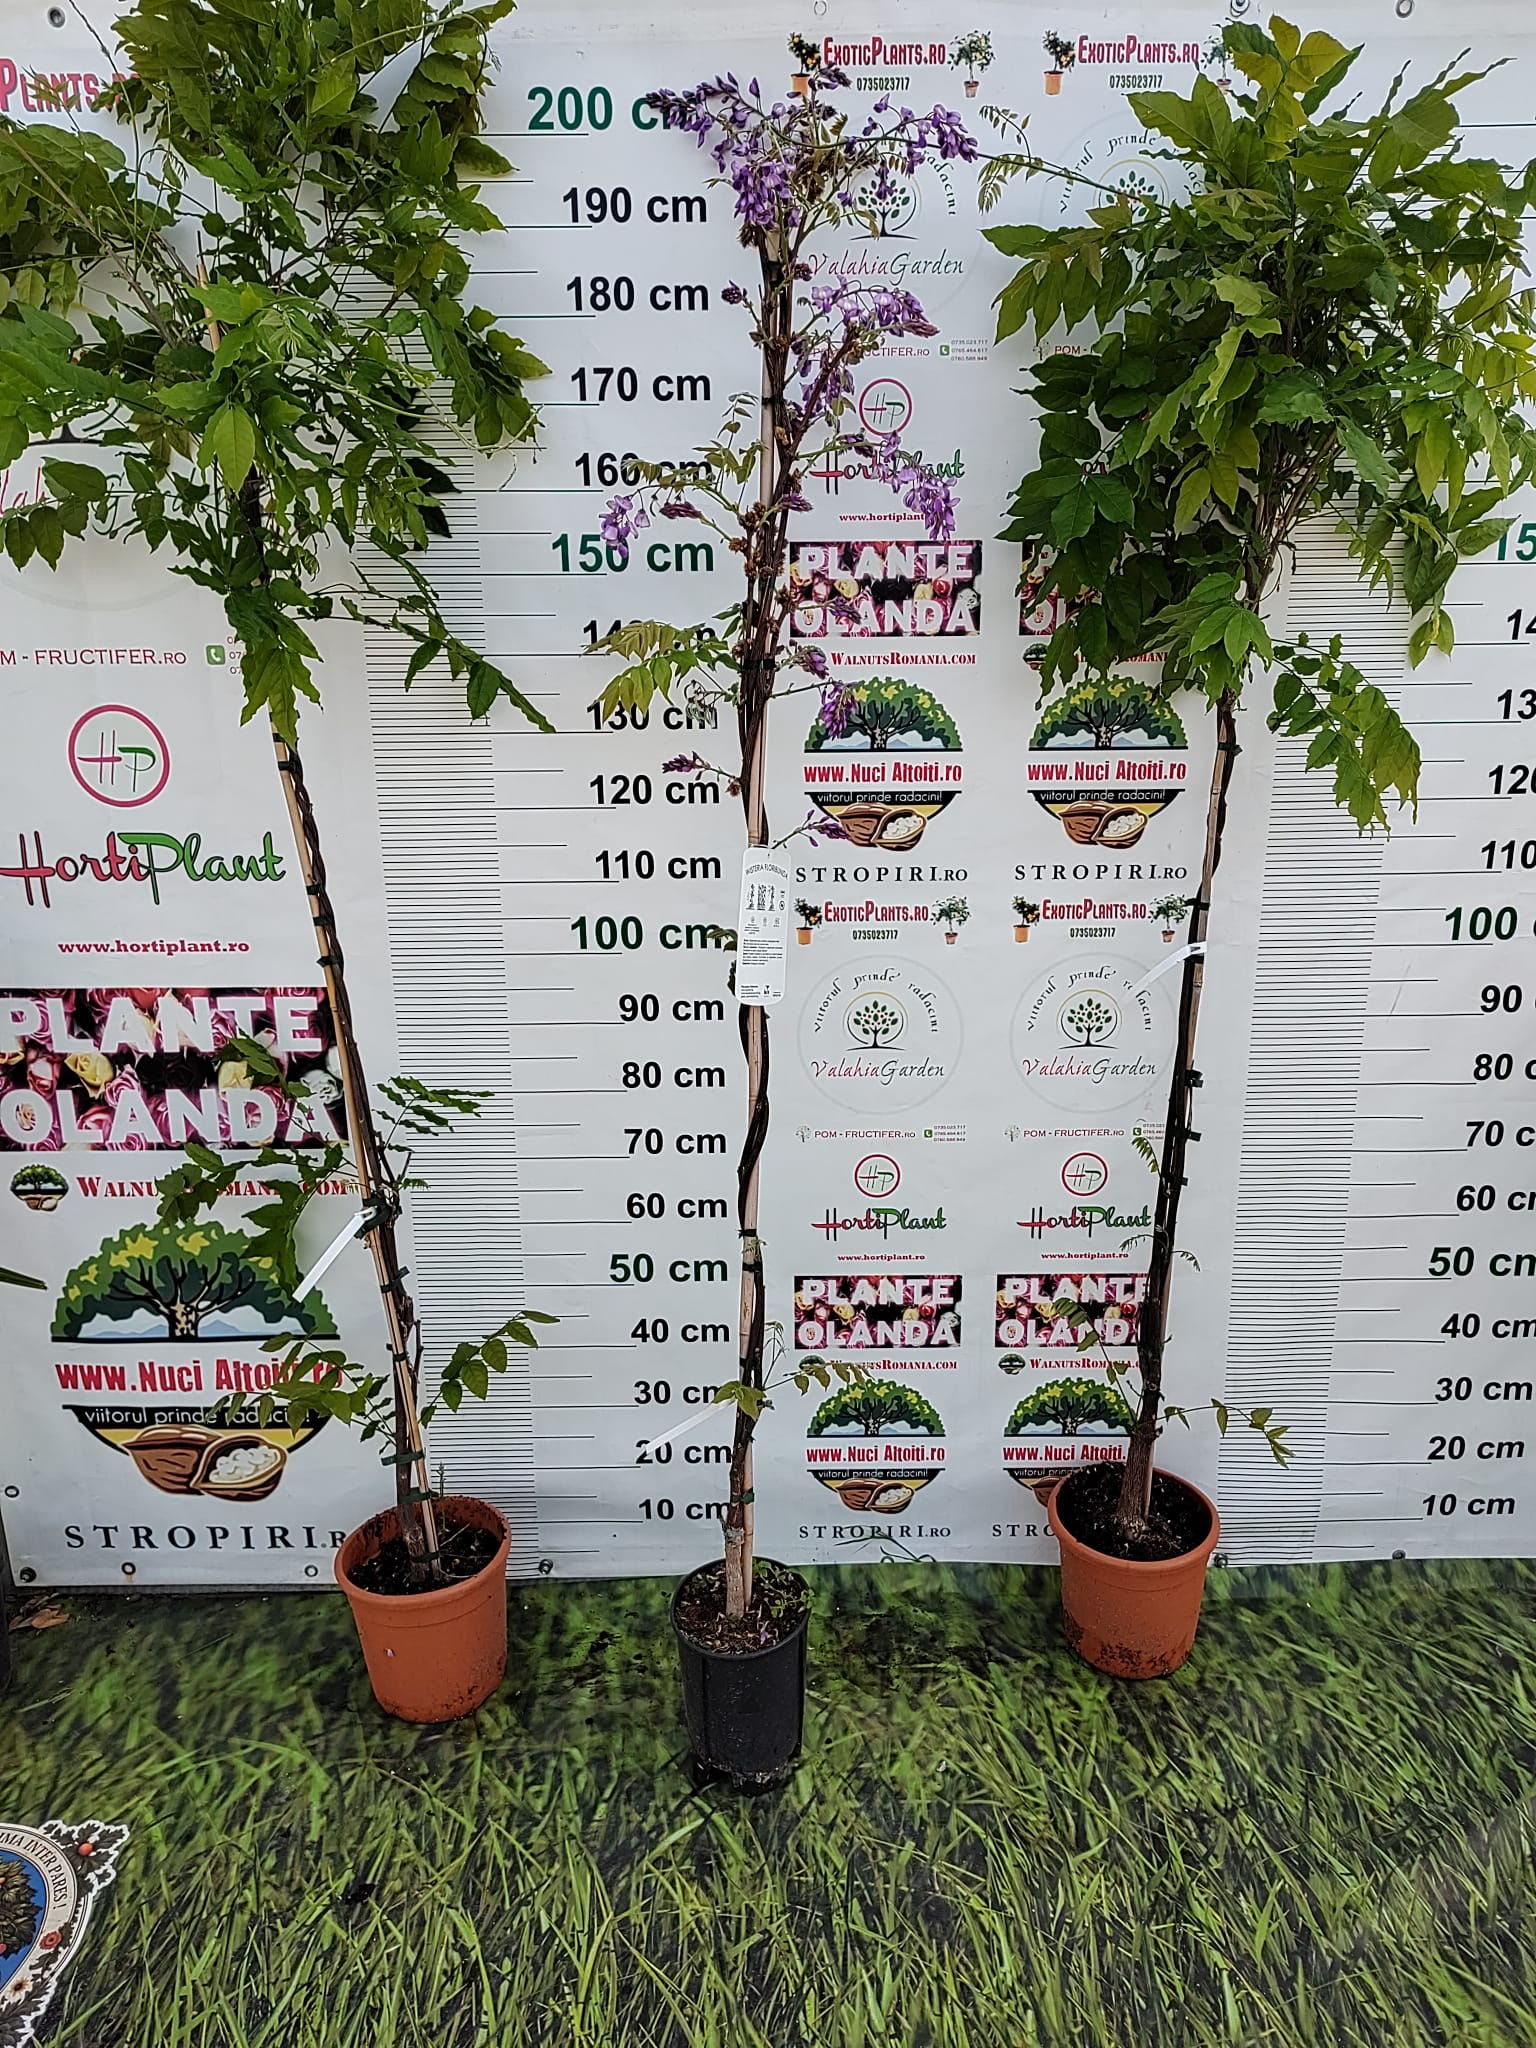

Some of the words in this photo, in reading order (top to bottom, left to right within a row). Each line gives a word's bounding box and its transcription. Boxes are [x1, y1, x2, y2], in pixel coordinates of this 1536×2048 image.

[856, 76, 910, 92] 0735023717
[1109, 74, 1163, 89] 0735023717
[527, 86, 613, 131] 200
[562, 186, 632, 223] 190
[646, 195, 707, 223] cm
[808, 248, 965, 286] ValahiaGarden
[566, 276, 635, 312] 180
[649, 284, 709, 311] cm
[571, 366, 638, 402] 170
[652, 374, 711, 402] cm
[646, 541, 714, 572] cm
[799, 545, 973, 580] PLANTE
[794, 599, 975, 634] OLANDA
[35, 649, 187, 666] FRUCTIFER.RO
[892, 762, 962, 782] Altoiti.ro
[1116, 760, 1186, 781] Altoiti.ro
[590, 774, 652, 804] 120
[665, 781, 720, 804] cm
[856, 792, 892, 803] prinde
[1079, 789, 1115, 801] prinde
[0, 830, 286, 909] HortiPlant
[595, 850, 655, 879] 110
[667, 856, 721, 880] cm
[795, 866, 968, 883] STROPIRI.RO
[1014, 864, 1188, 881] STROPIRI.RO
[571, 915, 644, 950] 100
[659, 924, 722, 950] cm
[852, 930, 899, 940] 0735023717
[1069, 927, 1116, 938] 0735023717
[1445, 906, 1518, 941] 100
[58, 939, 250, 956] www.hortiplant.ro
[618, 993, 660, 1022] 90
[672, 999, 724, 1022] cm
[1480, 985, 1522, 1013] 90
[0, 996, 323, 1054] PLANTE
[622, 1061, 662, 1089] 80
[673, 1067, 725, 1088] cm
[810, 1057, 945, 1086] ValahiaGarden
[1022, 1055, 1156, 1084] ValahiaGarden
[1473, 1053, 1514, 1080] 80
[0, 1089, 340, 1144] OLANDA
[623, 1128, 664, 1155] 70
[675, 1133, 727, 1154] cm
[814, 1130, 837, 1138] POM
[1023, 1129, 1047, 1138] POM
[1466, 1120, 1505, 1147] 70
[626, 1192, 666, 1219] 60
[677, 1197, 728, 1219] cm
[1456, 1184, 1496, 1211] 60
[811, 1206, 947, 1242] HortiPlant
[1016, 1204, 1152, 1240] HortiPlant
[609, 1253, 655, 1284] 50
[668, 1258, 729, 1283] cm
[837, 1253, 926, 1262] www.hortiplant.ro
[1041, 1251, 1129, 1261] www.hortiplant.ro
[1428, 1246, 1475, 1277] 50
[802, 1278, 955, 1305] PLANTE
[630, 1318, 669, 1344] 40
[680, 1323, 730, 1343] cm
[798, 1320, 957, 1347] OLANDA
[1441, 1313, 1480, 1339] 40
[634, 1380, 672, 1405] 30
[1435, 1376, 1472, 1402] 30
[1483, 1380, 1534, 1401] cm
[84, 1407, 147, 1424] viitorul
[635, 1439, 672, 1464] 20
[684, 1444, 732, 1464] cm
[884, 1445, 945, 1462] Altoiti.ro
[1427, 1436, 1466, 1460] 20
[1476, 1440, 1525, 1460] cm
[638, 1498, 674, 1520] 10
[1422, 1494, 1457, 1517] 10
[1467, 1497, 1516, 1516] cm
[64, 1524, 347, 1550] STROPIRI.R
[23, 1839, 58, 1868] INTER
